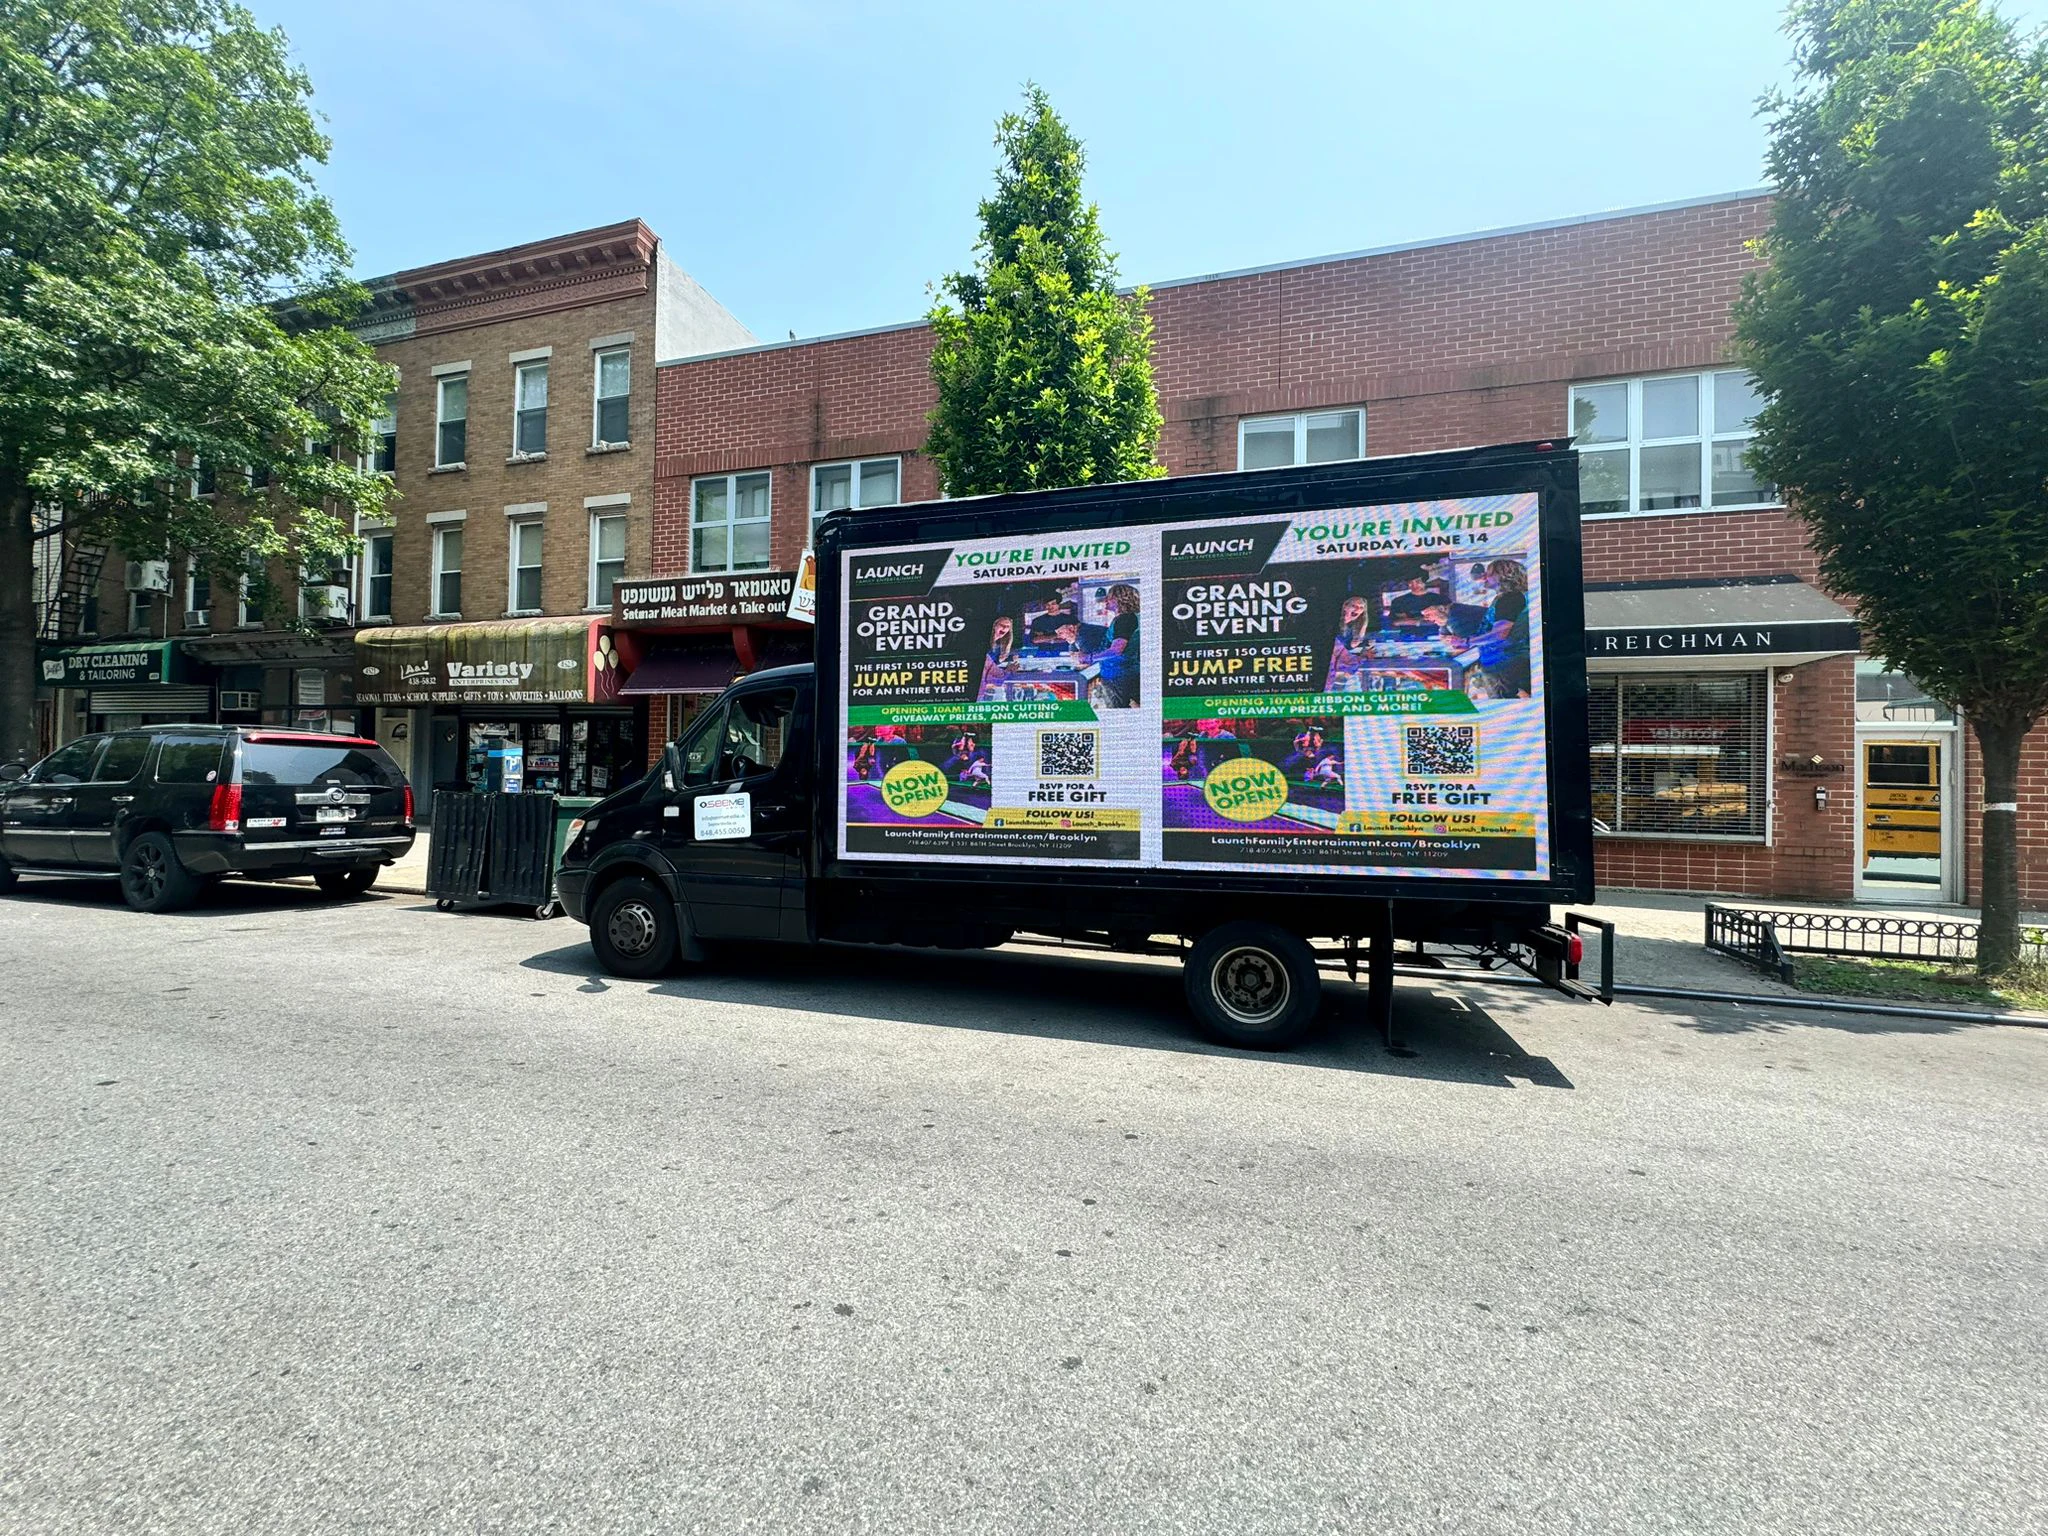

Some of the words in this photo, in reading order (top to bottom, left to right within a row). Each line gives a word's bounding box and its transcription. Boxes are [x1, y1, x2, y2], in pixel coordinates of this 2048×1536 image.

[1293, 520, 1391, 541] YOU'RE
[1402, 511, 1513, 534] INVITED
[1170, 539, 1254, 556] LAUNCH
[1316, 539, 1407, 554] SATURDAY,
[1415, 535, 1460, 547] JUNE
[1468, 533, 1488, 543] 14
[955, 548, 1034, 566] YOU'RE
[1042, 541, 1130, 560] INVITED
[856, 564, 924, 579] LAUNCH
[973, 566, 1046, 578] SATURDAY,
[1052, 562, 1088, 573] JUNE
[1094, 560, 1110, 570] 14
[621, 586, 676, 604] געשעפט
[682, 580, 724, 600] פלייש
[730, 579, 790, 598] סאטמאר
[1186, 581, 1292, 602] GRAND
[623, 608, 658, 620] Satmar
[661, 606, 687, 619] Meat
[689, 603, 728, 617] Market
[739, 602, 765, 614] Take
[768, 601, 786, 613] out
[868, 602, 953, 620] GRAND
[1172, 597, 1308, 620] OPENING
[856, 617, 965, 636] OPENING
[1196, 616, 1283, 636] EVENT
[876, 634, 946, 651] EVENT
[1170, 651, 1192, 659] THE
[1196, 649, 1230, 658] FIRST
[1235, 648, 1257, 656] 150
[1261, 646, 1312, 655] GUESTS
[69, 657, 91, 669] DRY
[92, 654, 148, 667] CLEANING
[447, 661, 533, 679] Variety
[854, 664, 872, 672] THE
[928, 660, 968, 669] GUESTS
[1168, 659, 1243, 676] JUMP
[1253, 656, 1312, 673] FREE
[80, 672, 85, 680] &
[88, 669, 135, 680] TAILORING
[853, 672, 913, 687] JUMP
[921, 670, 968, 684] FREE
[1168, 677, 1193, 686] FOR
[1198, 676, 1217, 685] AN
[1222, 675, 1265, 685] ENTIRE
[383, 693, 401, 701] ITEMS
[407, 693, 429, 701] SCHOOL
[432, 692, 457, 701] SUPPLIES
[463, 691, 481, 700] GIFTS
[487, 691, 504, 700] TOYS
[510, 691, 543, 700] NOVELTIES
[549, 690, 584, 700] BALLOONS
[853, 688, 873, 696] FOR
[1204, 698, 1263, 707] OPENING
[1314, 695, 1365, 704] RIBBON
[1370, 693, 1432, 703] CUTTING,
[882, 706, 928, 714] OPENING
[892, 714, 946, 722] GIVEAWAY
[949, 713, 986, 721] PRIZES,
[1218, 706, 1285, 715] GIVEAWAY
[1290, 705, 1337, 713] PRIZES,
[1342, 704, 1372, 712] AND
[1377, 703, 1422, 711] MORE!
[886, 772, 938, 795] NOW
[1209, 770, 1275, 796] NOW
[891, 786, 943, 806] OPEN!
[1029, 792, 1064, 801] FREE
[1070, 792, 1107, 802] GIFT
[1216, 786, 1281, 809] OPEN!
[1392, 793, 1437, 804] FREE
[1445, 793, 1491, 805] GIFT
[1026, 810, 1072, 818] FOLLOW
[1389, 814, 1448, 822] FOLLOW
[1452, 815, 1476, 823] US!
[885, 830, 1097, 843] LaunchFamilyEntertainment.com/Brooklyn
[1212, 836, 1480, 850] LaunchFamilyEntertainment.com/Brooklyn
